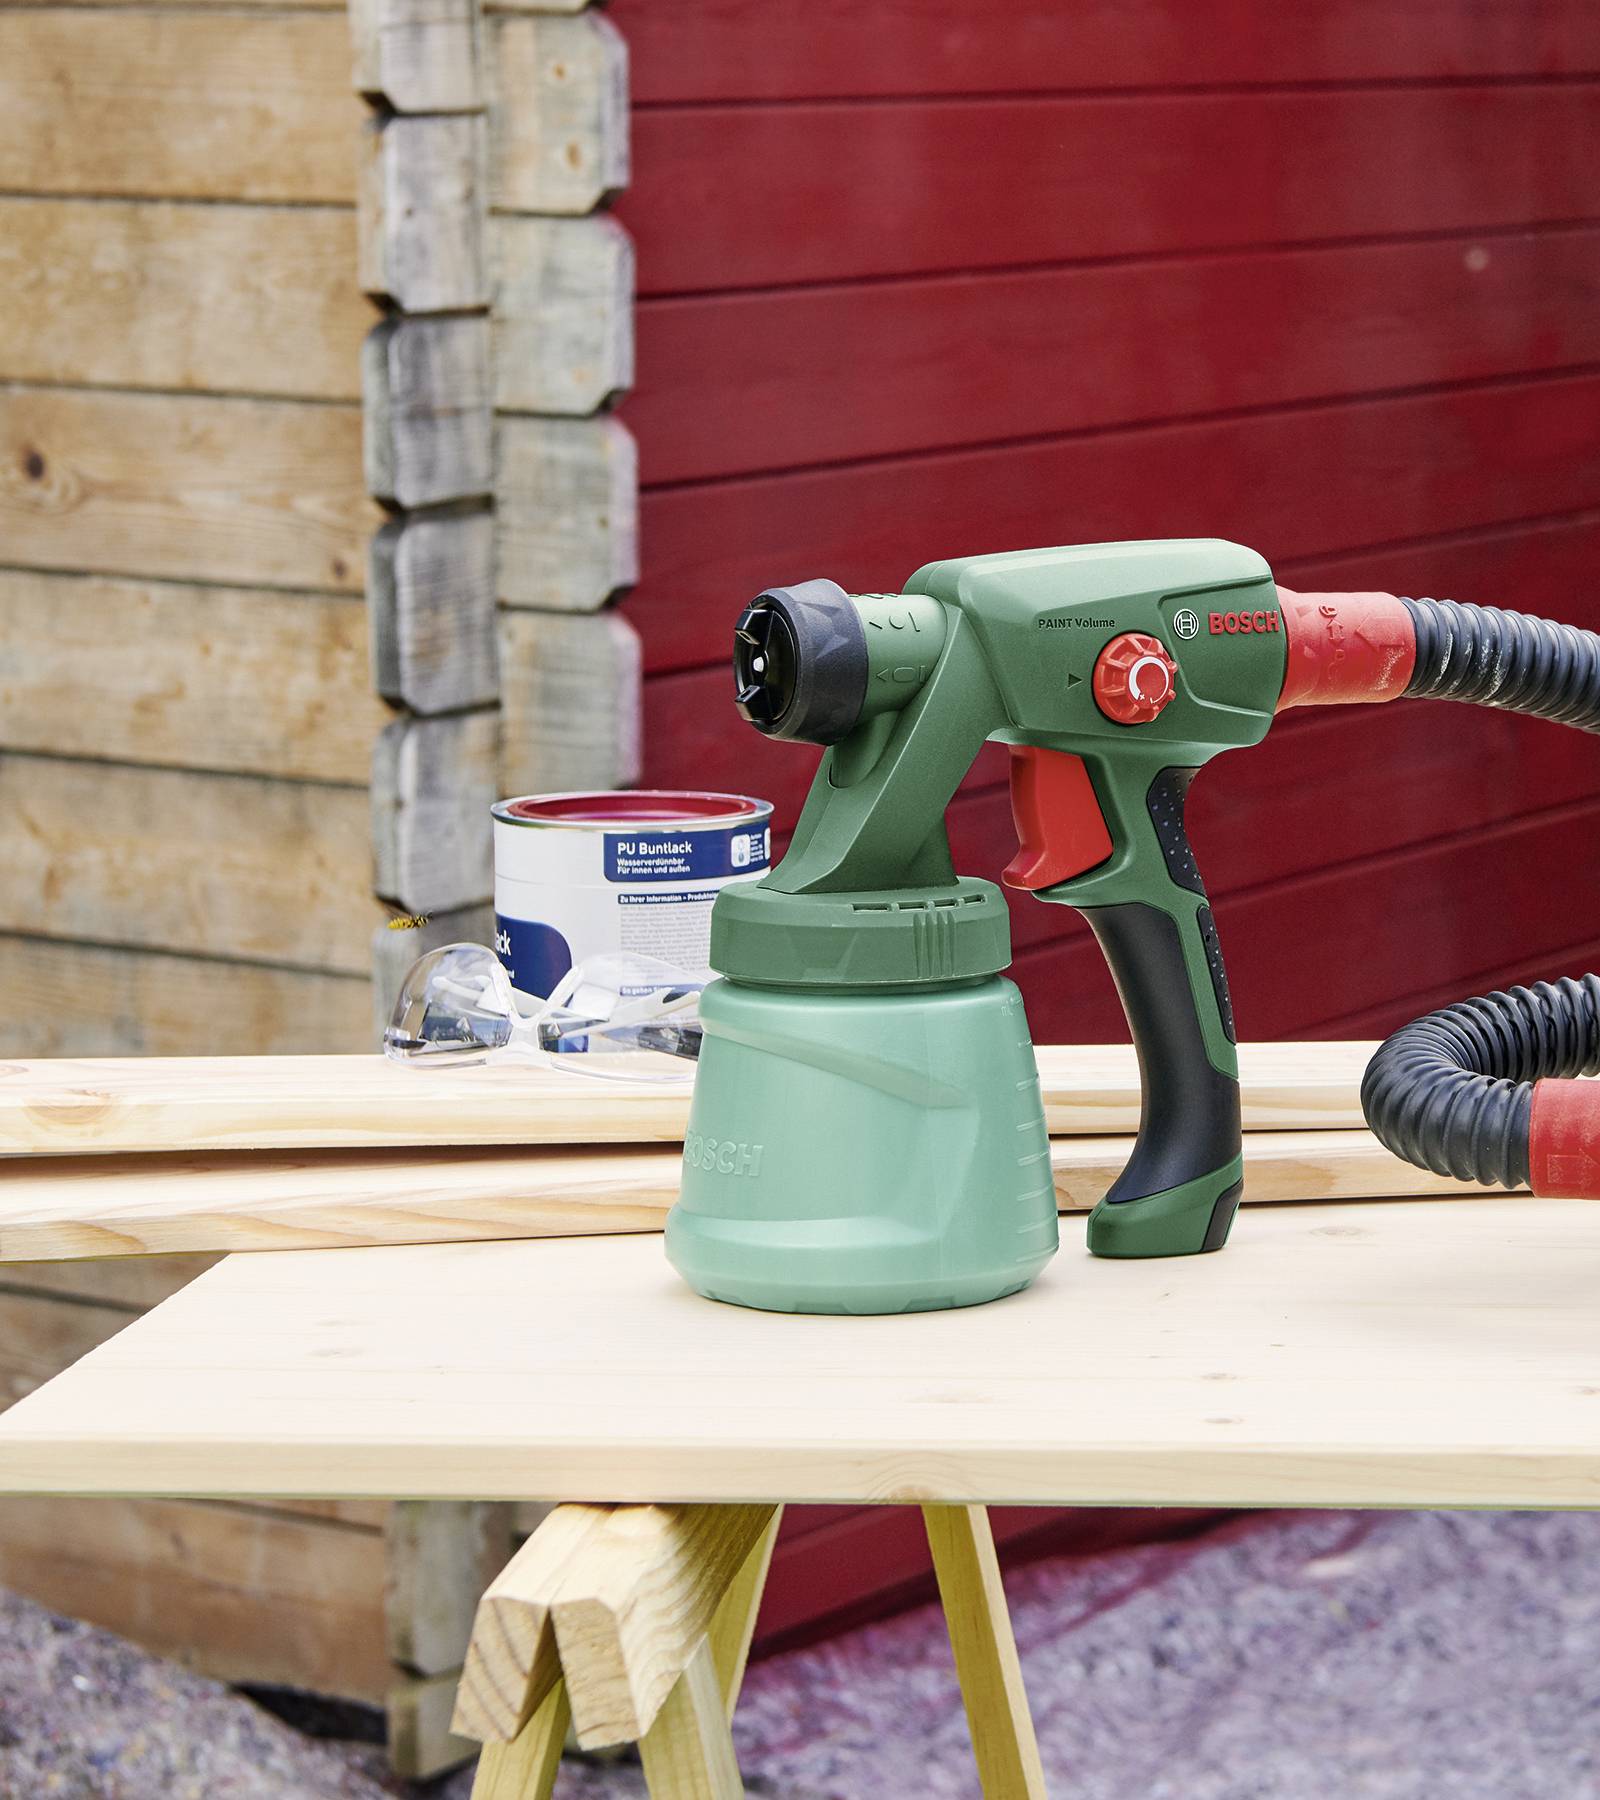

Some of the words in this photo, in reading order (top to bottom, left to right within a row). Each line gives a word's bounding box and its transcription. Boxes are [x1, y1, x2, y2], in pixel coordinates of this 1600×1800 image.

[1038, 618, 1073, 629] PAINT
[1074, 617, 1115, 629] Volume
[1208, 610, 1280, 635] BOSCH
[617, 842, 636, 855] PU
[639, 841, 693, 855] Buntlack
[617, 858, 685, 867] Wasserverdünnbar
[617, 866, 631, 874] Für
[653, 866, 668, 874] und
